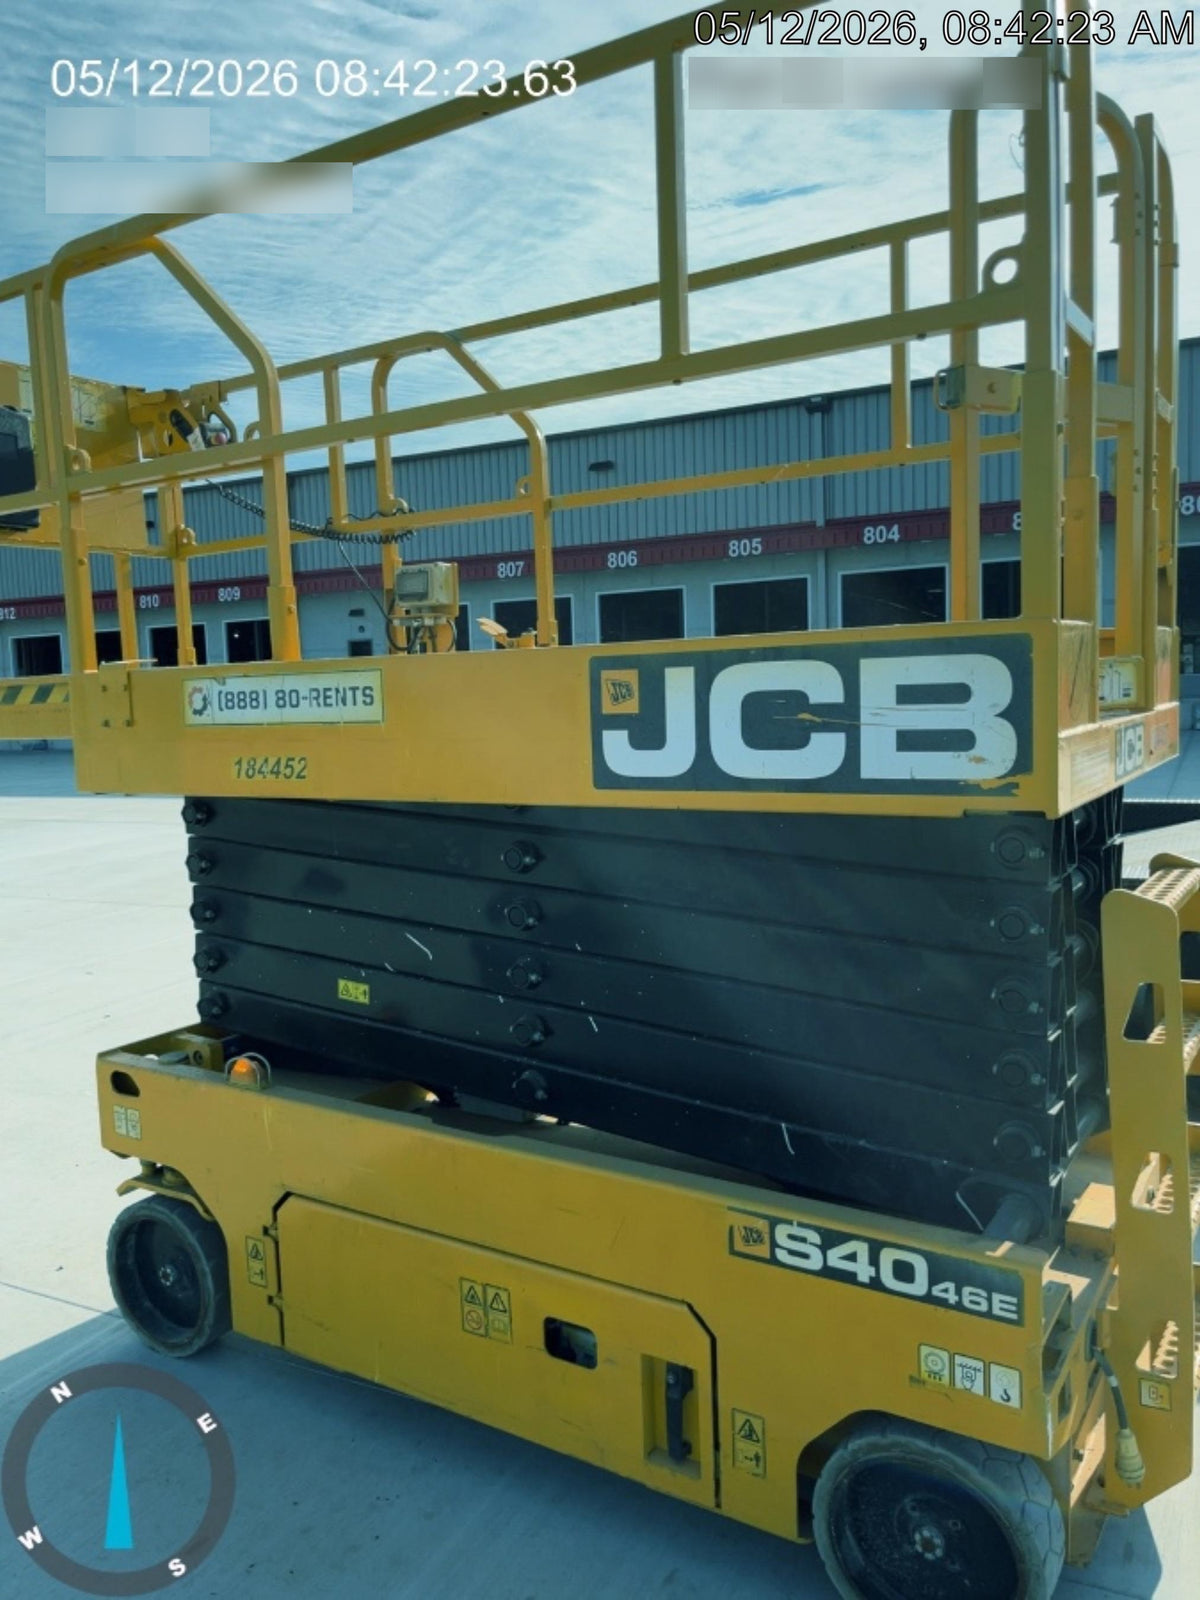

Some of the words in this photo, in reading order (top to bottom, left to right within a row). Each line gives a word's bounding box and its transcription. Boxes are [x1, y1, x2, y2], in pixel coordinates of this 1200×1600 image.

[863, 524, 901, 545] 804
[728, 537, 762, 558] 805
[497, 561, 525, 579] 807
[607, 550, 638, 569] 806
[139, 594, 160, 609] 810
[217, 587, 241, 601] 809
[274, 685, 376, 710] 80-RENTS
[602, 654, 1018, 780] JCB
[233, 756, 308, 780] 184452
